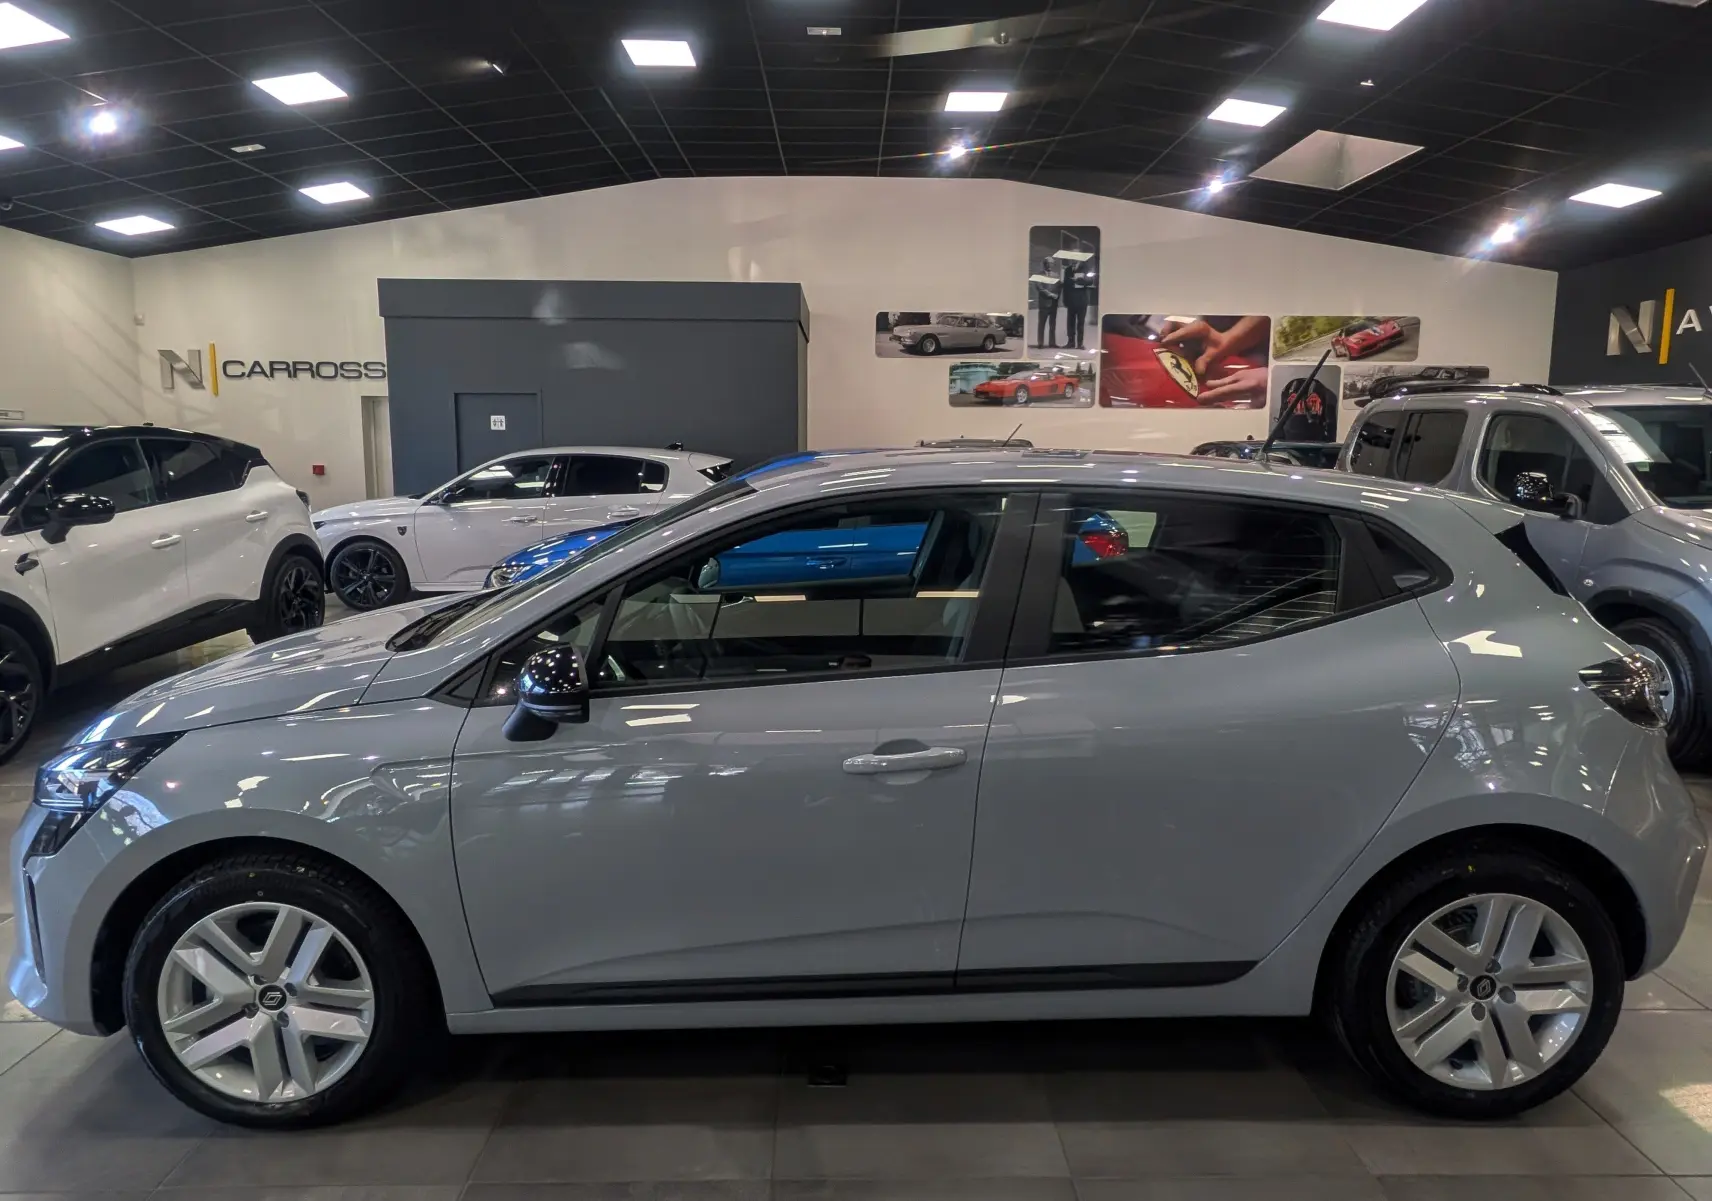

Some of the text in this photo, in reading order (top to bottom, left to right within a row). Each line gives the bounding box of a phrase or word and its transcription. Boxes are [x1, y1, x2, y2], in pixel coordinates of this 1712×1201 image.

[1606, 299, 1712, 356] N A
[157, 349, 387, 390] N CARROSS
